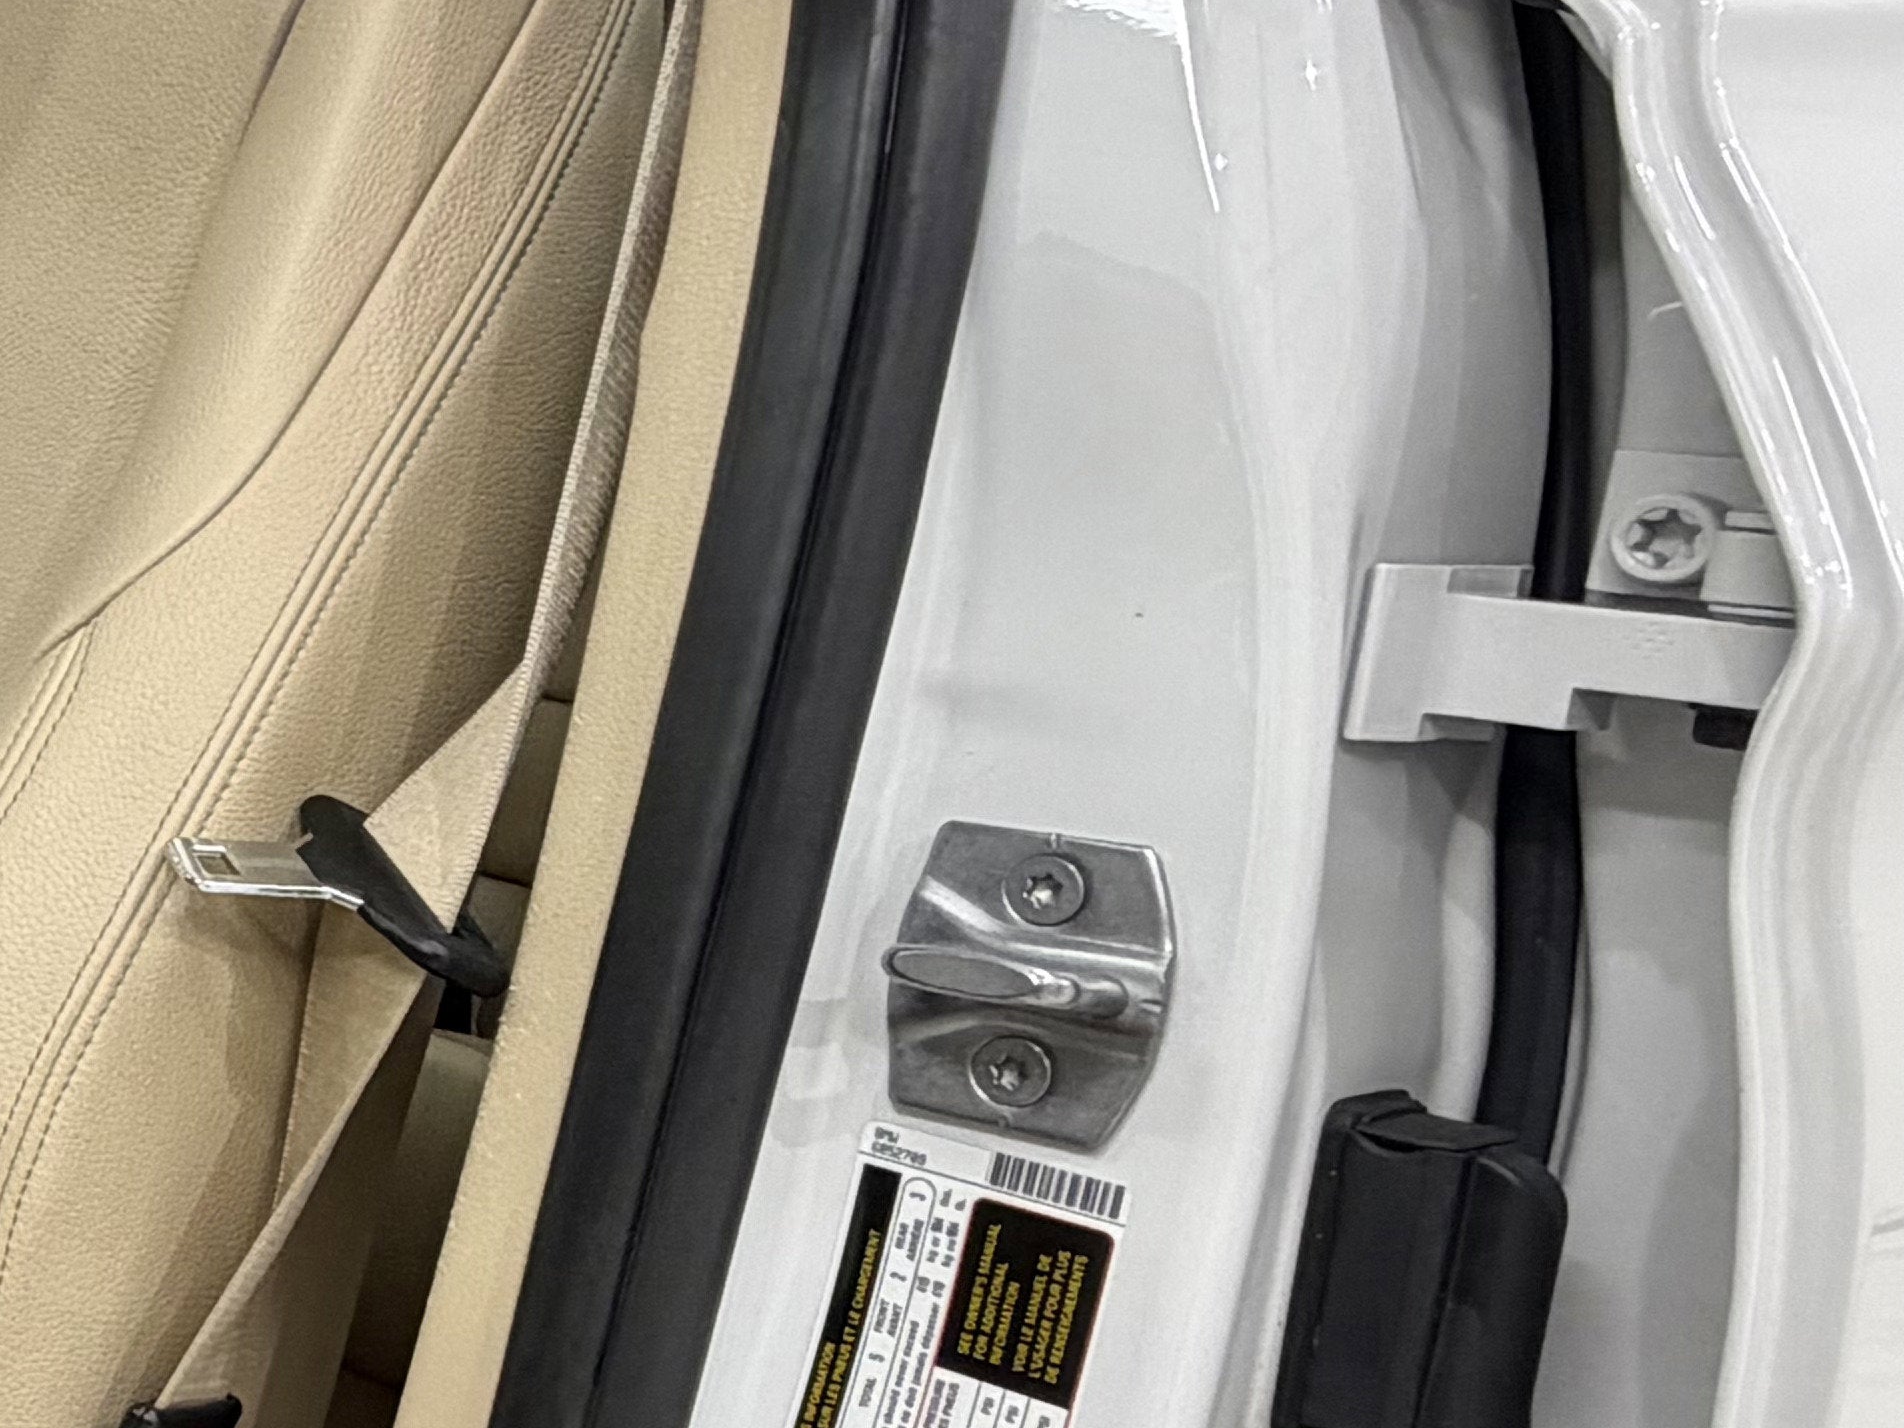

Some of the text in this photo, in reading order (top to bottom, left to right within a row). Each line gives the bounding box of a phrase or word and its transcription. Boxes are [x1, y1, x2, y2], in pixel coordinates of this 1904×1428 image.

[852, 1229, 880, 1309] CHARGEMENT
[957, 1224, 1002, 1355] SEE OWNER'S MANUAL
[1043, 1283, 1062, 1318] POUR
[1052, 1250, 1072, 1283] PLUS
[842, 1326, 856, 1343] ET
[848, 1310, 862, 1326] LE
[972, 1263, 1009, 1360] FOR ADDITIONAL
[989, 1281, 1020, 1365] INFORMATION
[1012, 1254, 1053, 1372] VOIR LE MANUEL DE
[1044, 1255, 1088, 1384] DE RENSEIGNEMENTS
[804, 1342, 835, 1422] INFORMATION
[824, 1383, 841, 1405] LES
